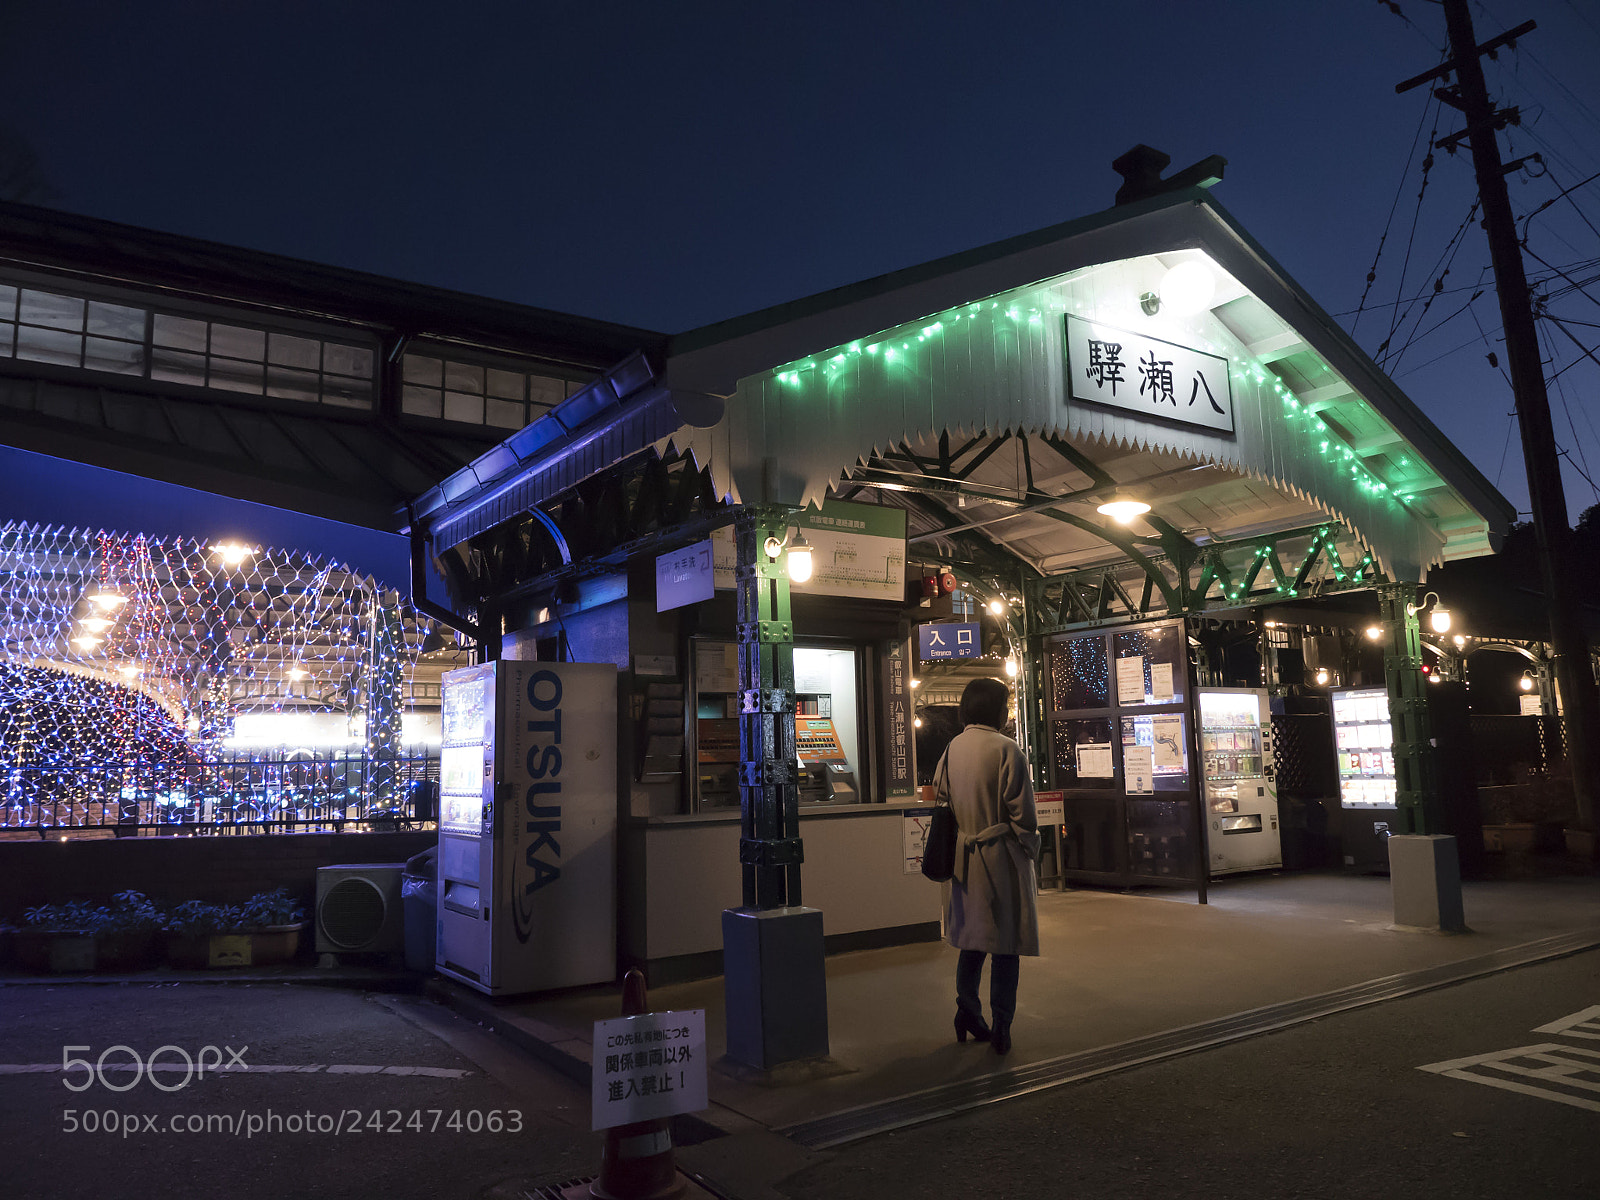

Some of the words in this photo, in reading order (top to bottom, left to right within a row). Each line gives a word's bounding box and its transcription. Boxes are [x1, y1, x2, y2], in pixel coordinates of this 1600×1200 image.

[929, 630, 972, 646] 入口
[930, 649, 952, 657] Entrance
[958, 648, 971, 656] 입구
[895, 701, 907, 780] 八瀬比叡山口駅
[526, 669, 563, 895] OTSUKA
[607, 1026, 690, 1048] この先私有地につき
[605, 1044, 693, 1074] 関係車両以外
